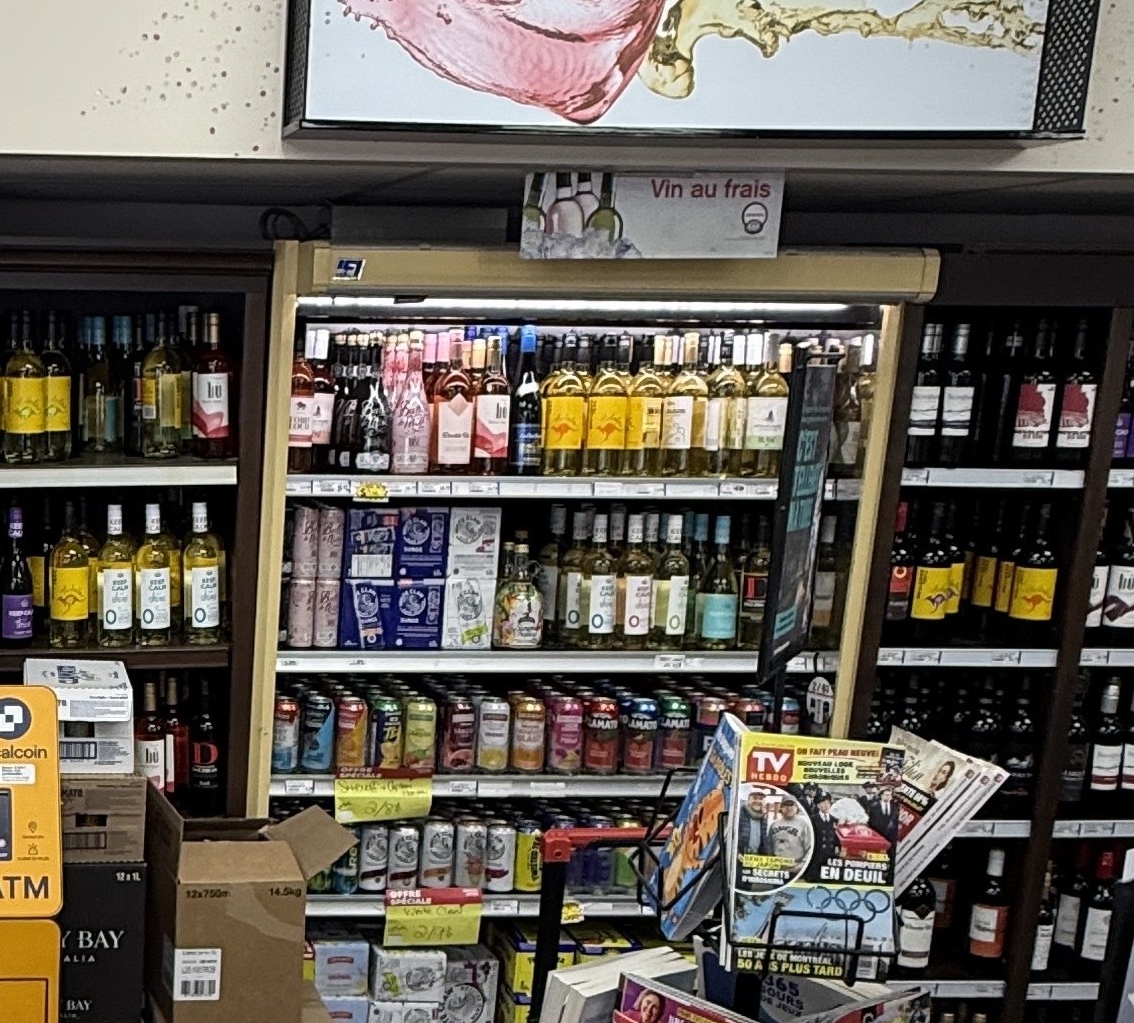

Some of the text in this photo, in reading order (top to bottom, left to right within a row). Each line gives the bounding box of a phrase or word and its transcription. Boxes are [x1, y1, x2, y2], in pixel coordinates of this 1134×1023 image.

[650, 178, 772, 199] Vin au frais
[587, 718, 618, 730] LAMATO
[628, 718, 658, 730] LAMATO
[661, 717, 691, 729] LAMATO
[192, 742, 219, 765] D
[808, 748, 827, 756] FAIT
[827, 748, 848, 757] PEAU
[751, 751, 791, 773] TV
[751, 773, 788, 782] HEBDO
[827, 858, 888, 871] LES POMPIERS
[820, 866, 887, 884] EN DEUIL
[268, 887, 302, 898] 14.5kg
[389, 889, 422, 898] OFFRE
[78, 930, 125, 949] BAY
[737, 958, 843, 977] 50 AS PLUS TARD
[66, 1000, 93, 1011] BAY
